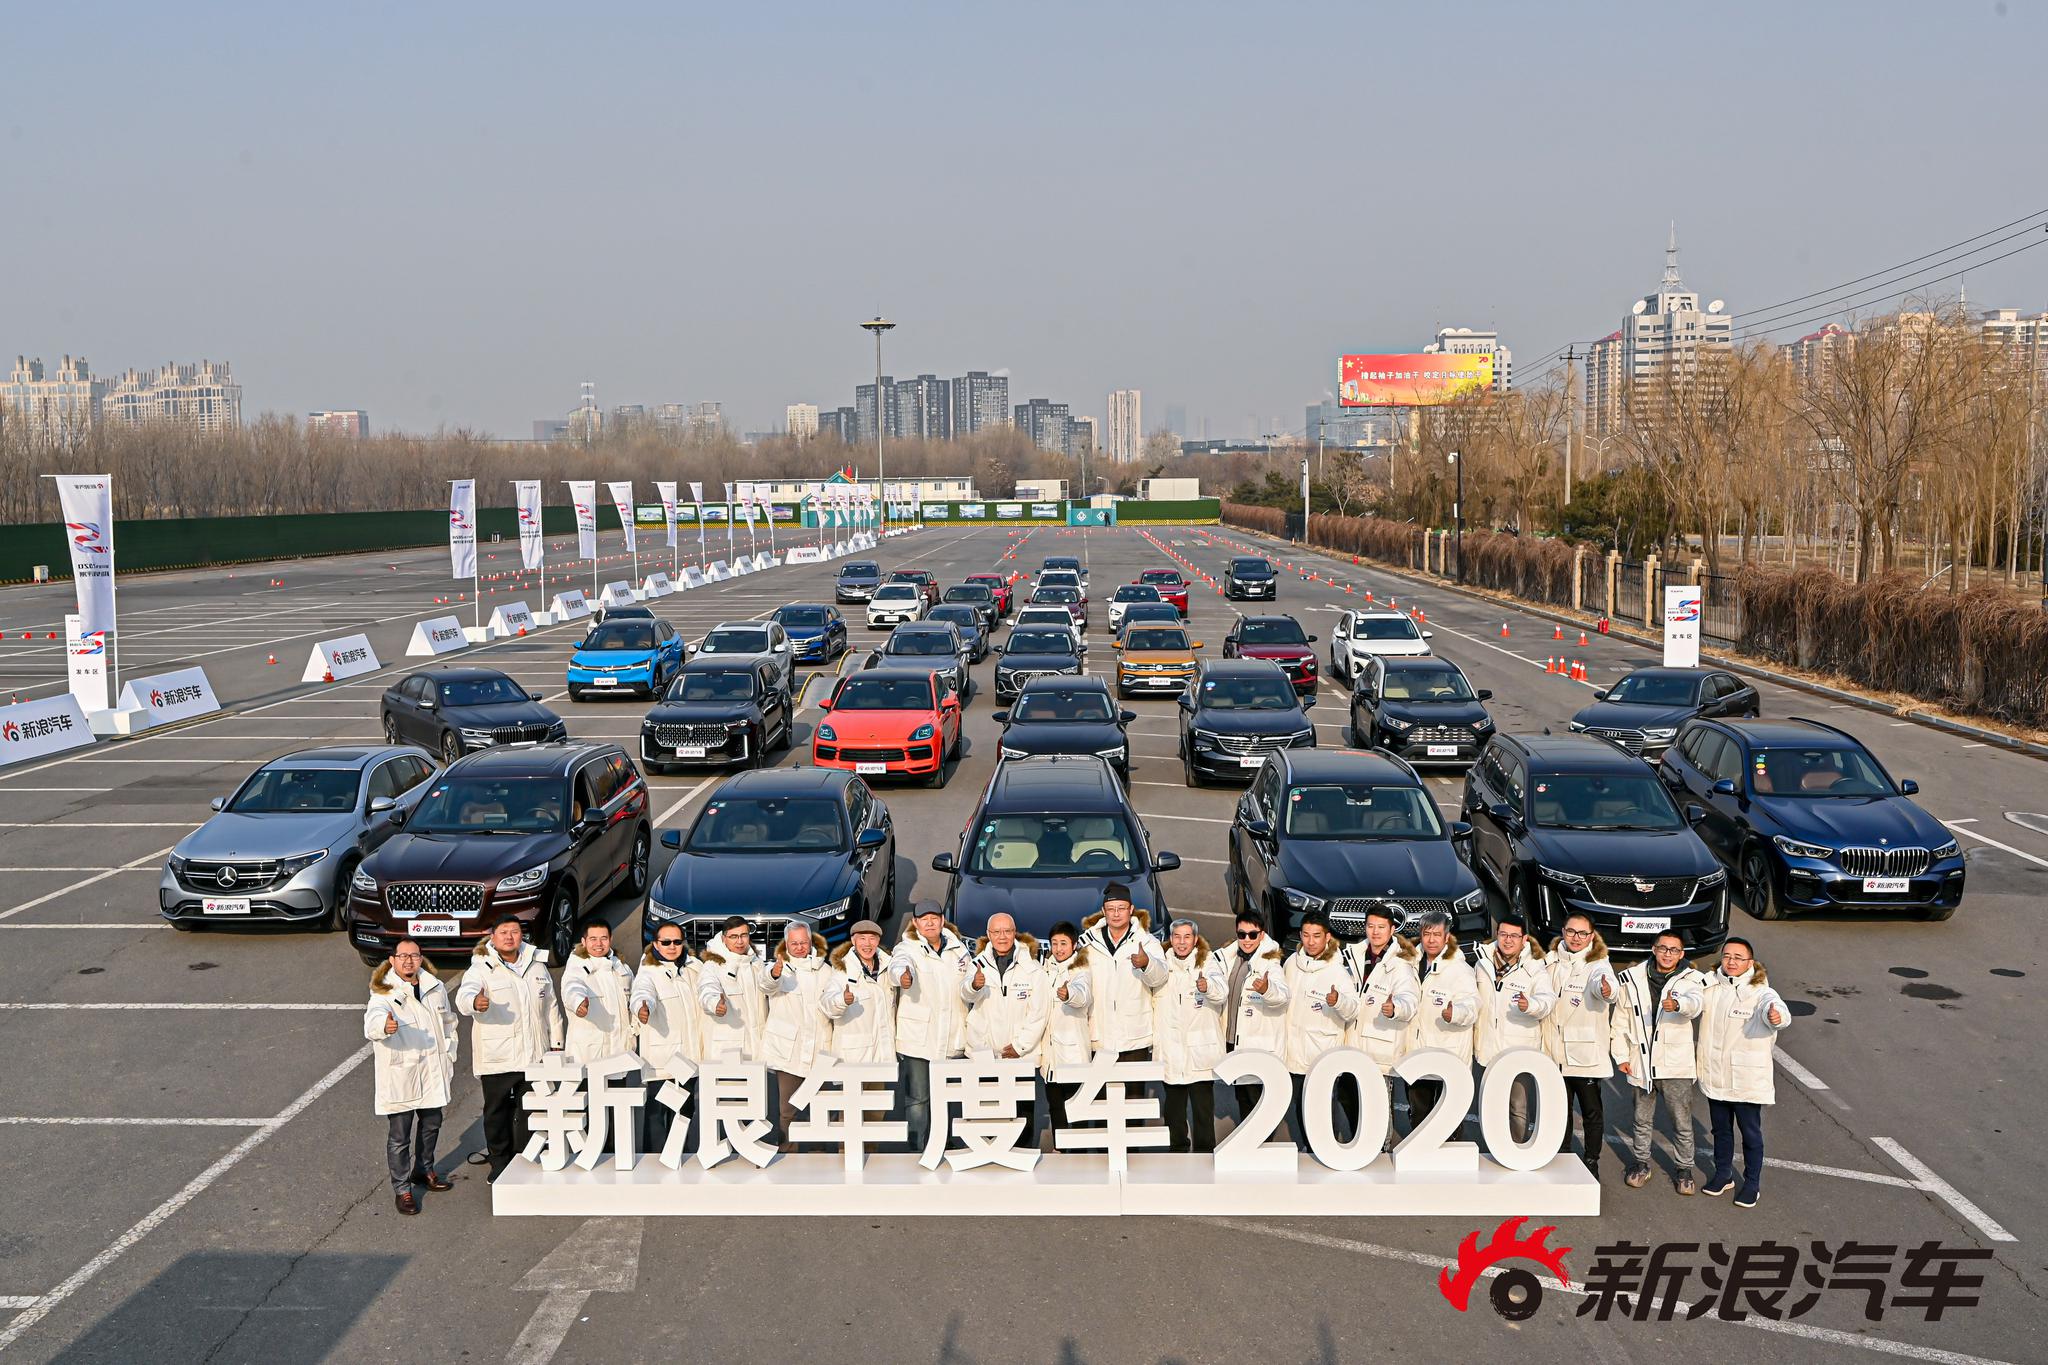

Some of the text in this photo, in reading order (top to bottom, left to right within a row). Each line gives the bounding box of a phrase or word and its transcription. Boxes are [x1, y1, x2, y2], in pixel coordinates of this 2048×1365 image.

[163, 685, 202, 706] 新浪汽车
[20, 714, 73, 740] 新浪汽车
[1876, 882, 1906, 890] 新浪汽车
[423, 925, 456, 933] 新浪汽车
[1635, 922, 1667, 930] 新浪汽车
[521, 1046, 1569, 1172] 新浪年度车 2020
